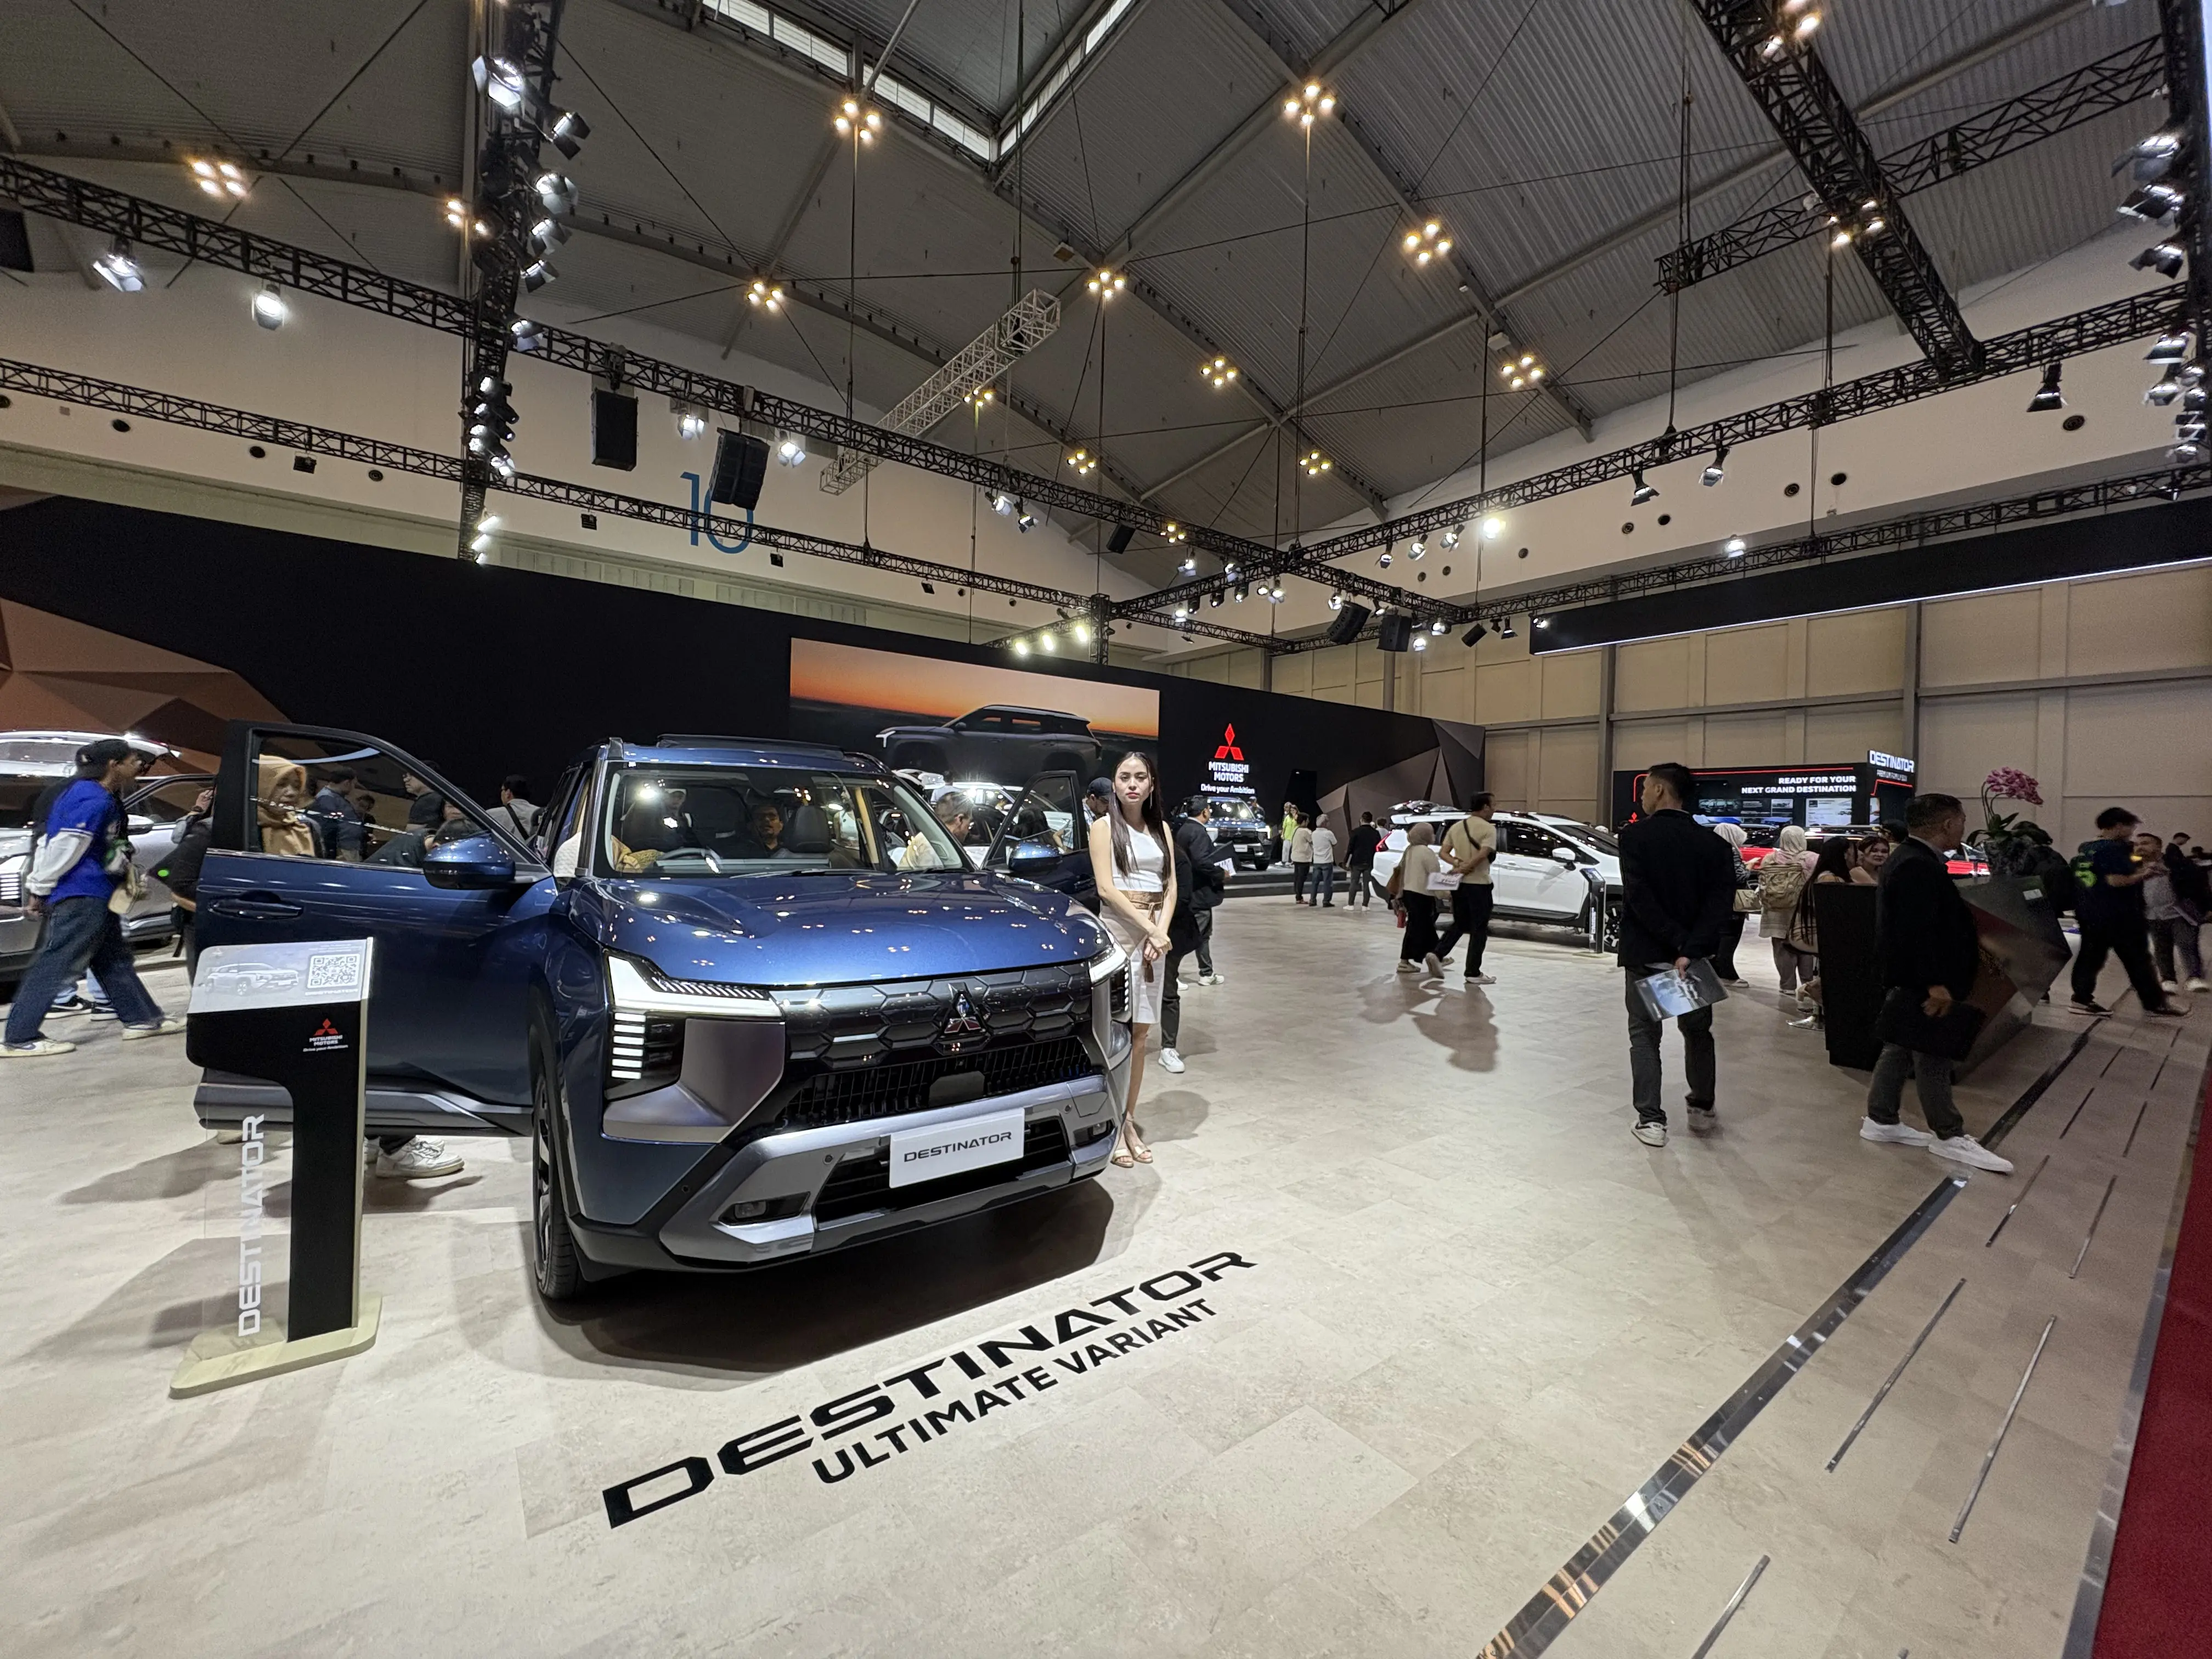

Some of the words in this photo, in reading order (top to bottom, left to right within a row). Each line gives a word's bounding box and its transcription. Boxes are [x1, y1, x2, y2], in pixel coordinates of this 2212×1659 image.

[680, 471, 754, 554] 10
[1209, 761, 1249, 773] MITSUBISHI
[1214, 771, 1244, 783] MOTORS
[1869, 750, 1915, 773] DESTINATOR
[1200, 783, 1216, 792] Drive
[1216, 786, 1229, 794] your
[1229, 785, 1255, 794] Ambition
[904, 1131, 1012, 1163] DESTINATOR
[239, 1113, 264, 1337] DESTINATOR
[602, 1251, 1258, 1530] DESTINATOR
[812, 1365, 1058, 1483] ULTIMATE
[1052, 1298, 1217, 1374] VARIANT
